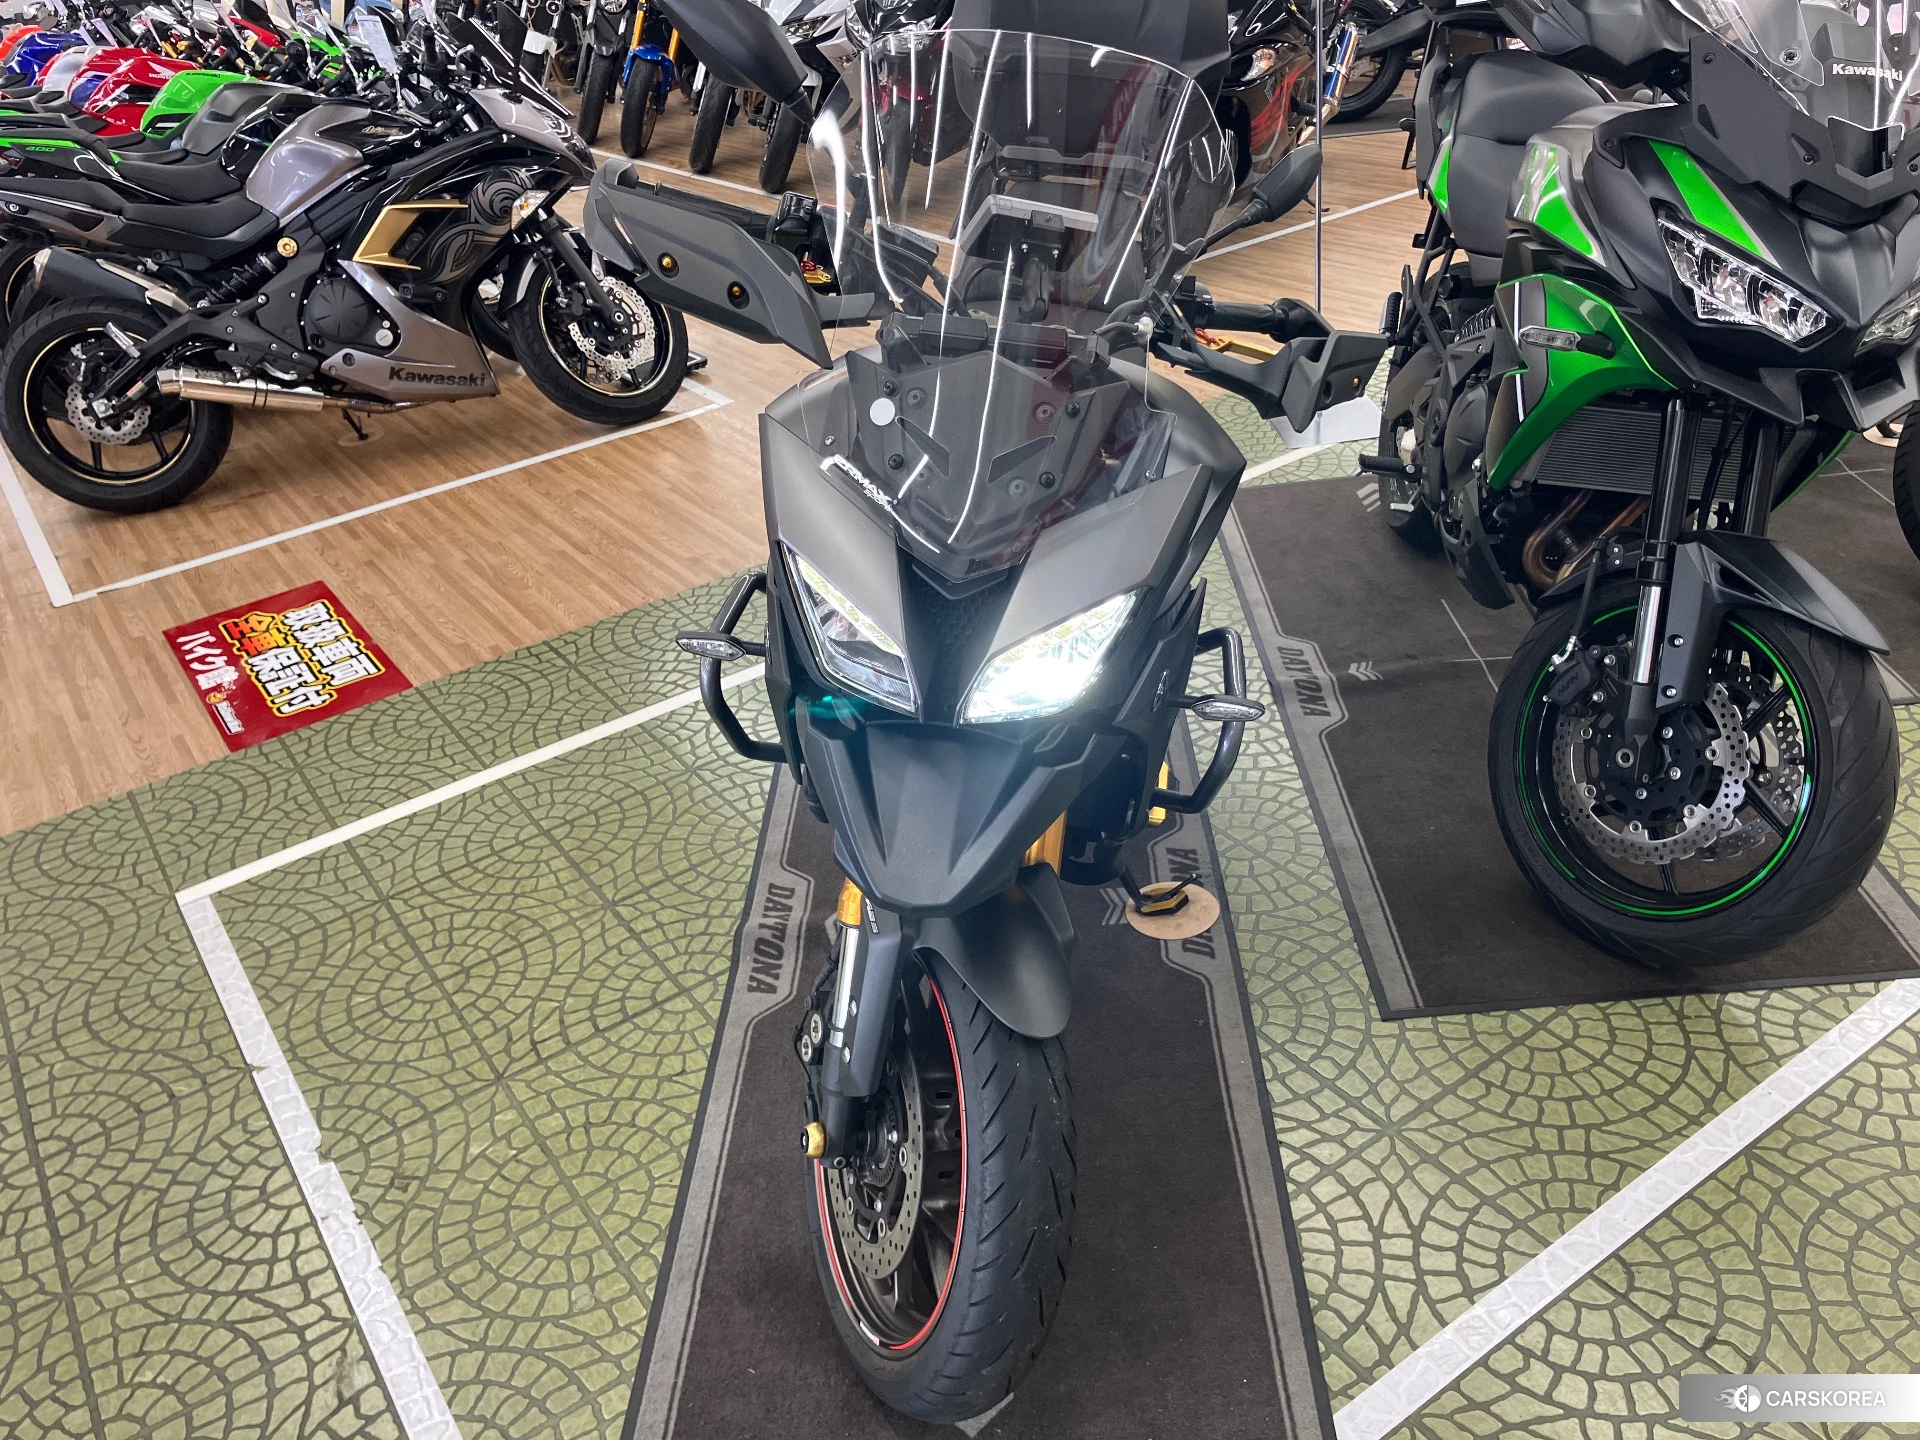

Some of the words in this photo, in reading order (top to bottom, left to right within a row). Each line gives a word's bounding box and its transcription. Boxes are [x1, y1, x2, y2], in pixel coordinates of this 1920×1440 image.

[1832, 64, 1903, 82] Kawasaki
[389, 366, 486, 388] Kawasaki
[224, 612, 332, 715] 全車保証付
[282, 601, 378, 687] 取扱車両
[1277, 646, 1332, 717] DAYTONA
[747, 882, 796, 995] DAYTONA
